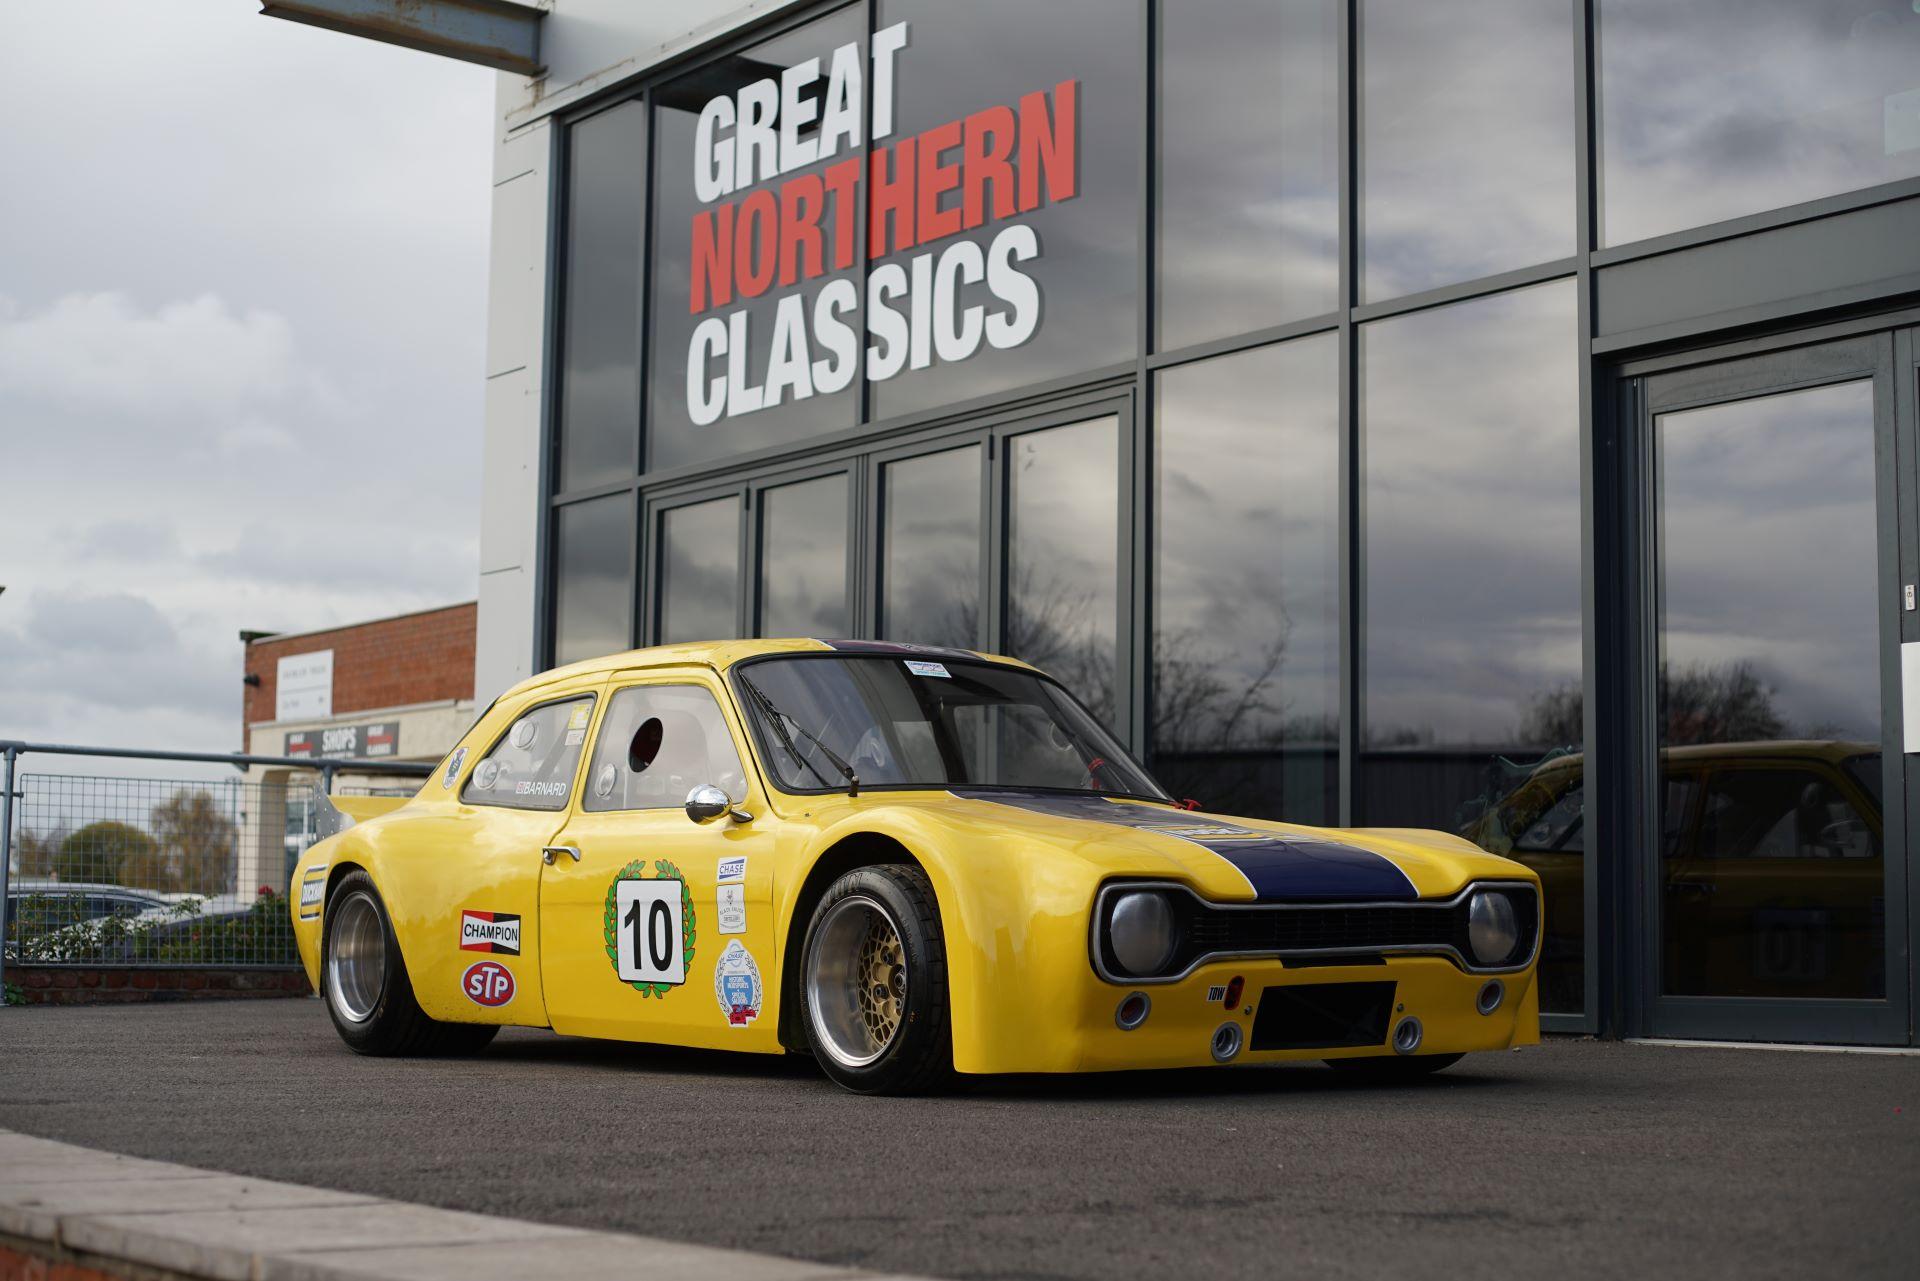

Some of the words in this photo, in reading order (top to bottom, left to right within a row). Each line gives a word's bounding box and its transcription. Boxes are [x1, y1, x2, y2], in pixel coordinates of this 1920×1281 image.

[694, 21, 907, 203] GREAT
[690, 79, 1077, 314] NORTHERN
[687, 224, 1039, 426] CLASSICS
[321, 727, 357, 751] SHOPS
[523, 782, 566, 796] BARNARD
[719, 864, 744, 874] CHASE
[464, 923, 518, 941] CHAMPION
[624, 899, 673, 971] 10
[469, 966, 509, 999] STP
